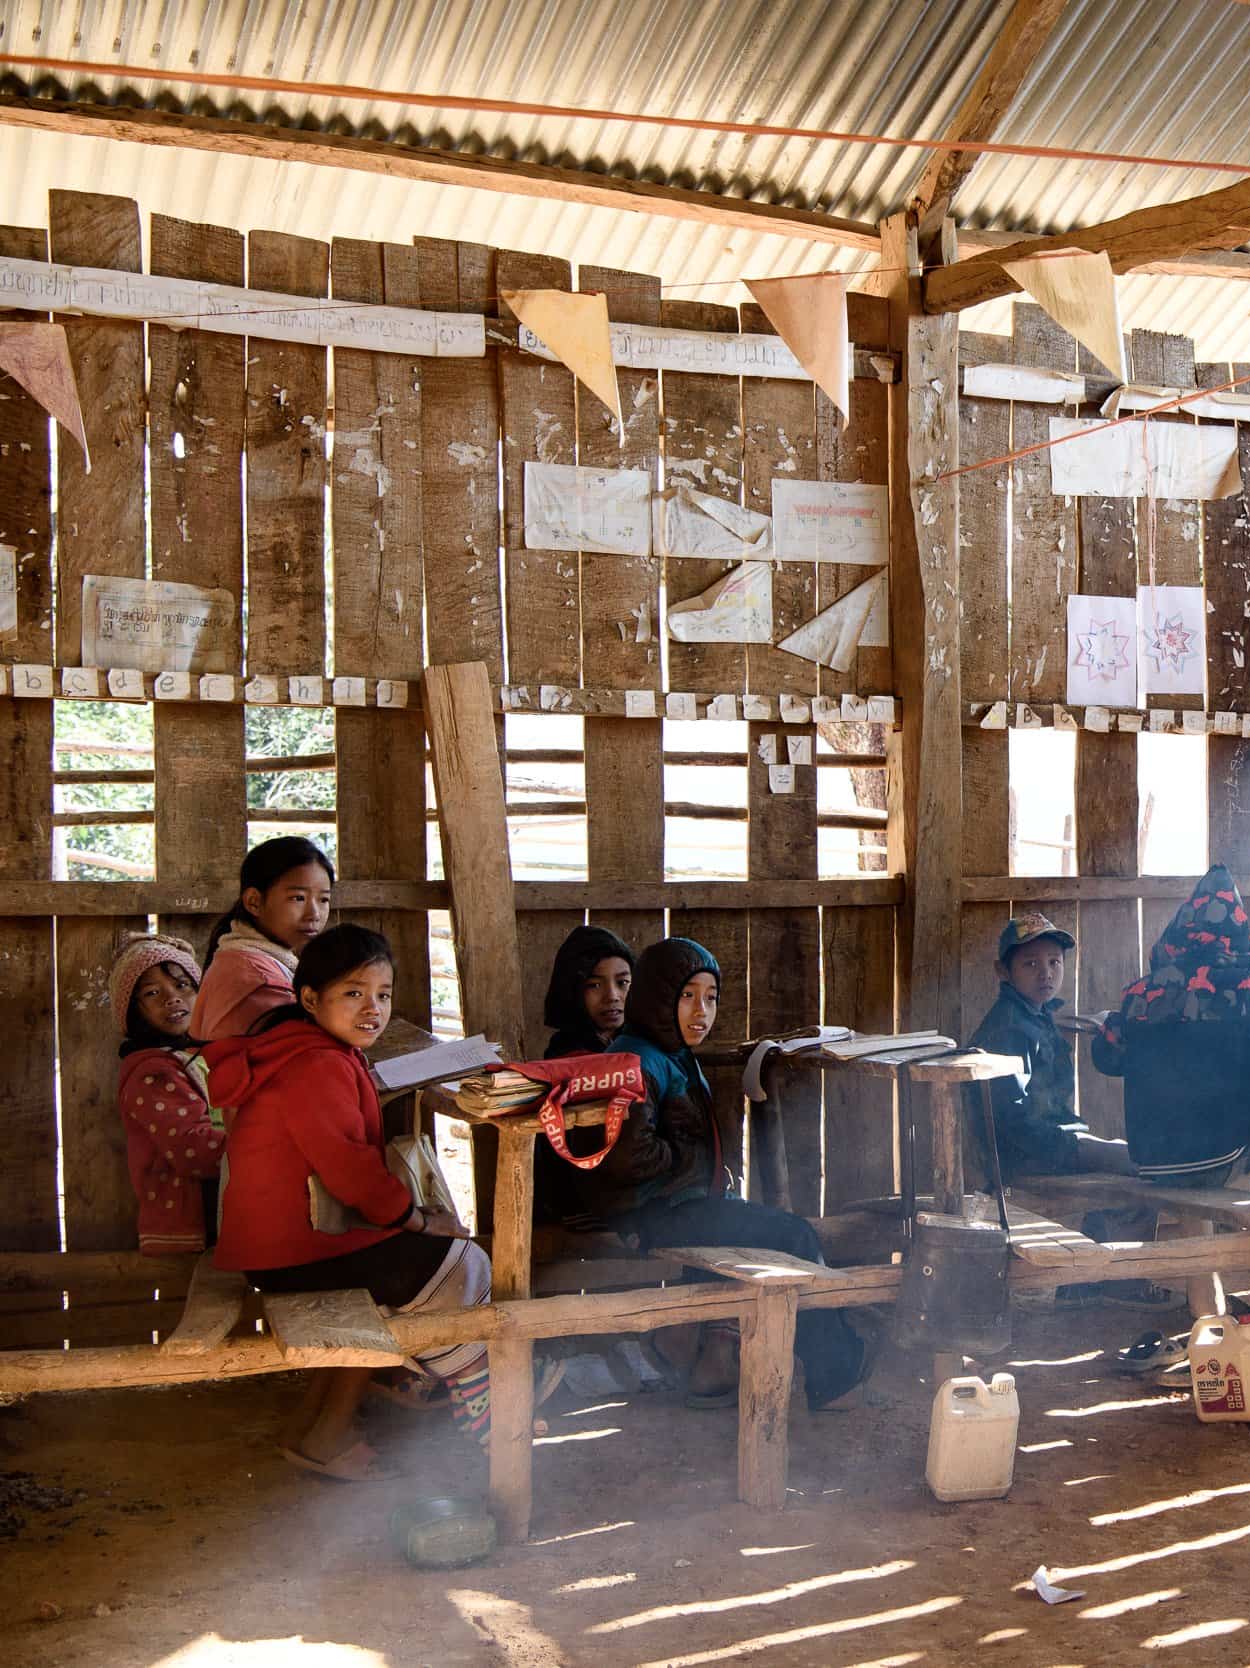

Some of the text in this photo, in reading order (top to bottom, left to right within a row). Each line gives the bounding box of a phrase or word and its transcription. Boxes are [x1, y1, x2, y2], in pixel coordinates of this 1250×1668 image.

[25, 670, 42, 689] b
[115, 672, 127, 689] d
[160, 676, 176, 693] e
[297, 679, 309, 698] h
[1024, 707, 1033, 724] B
